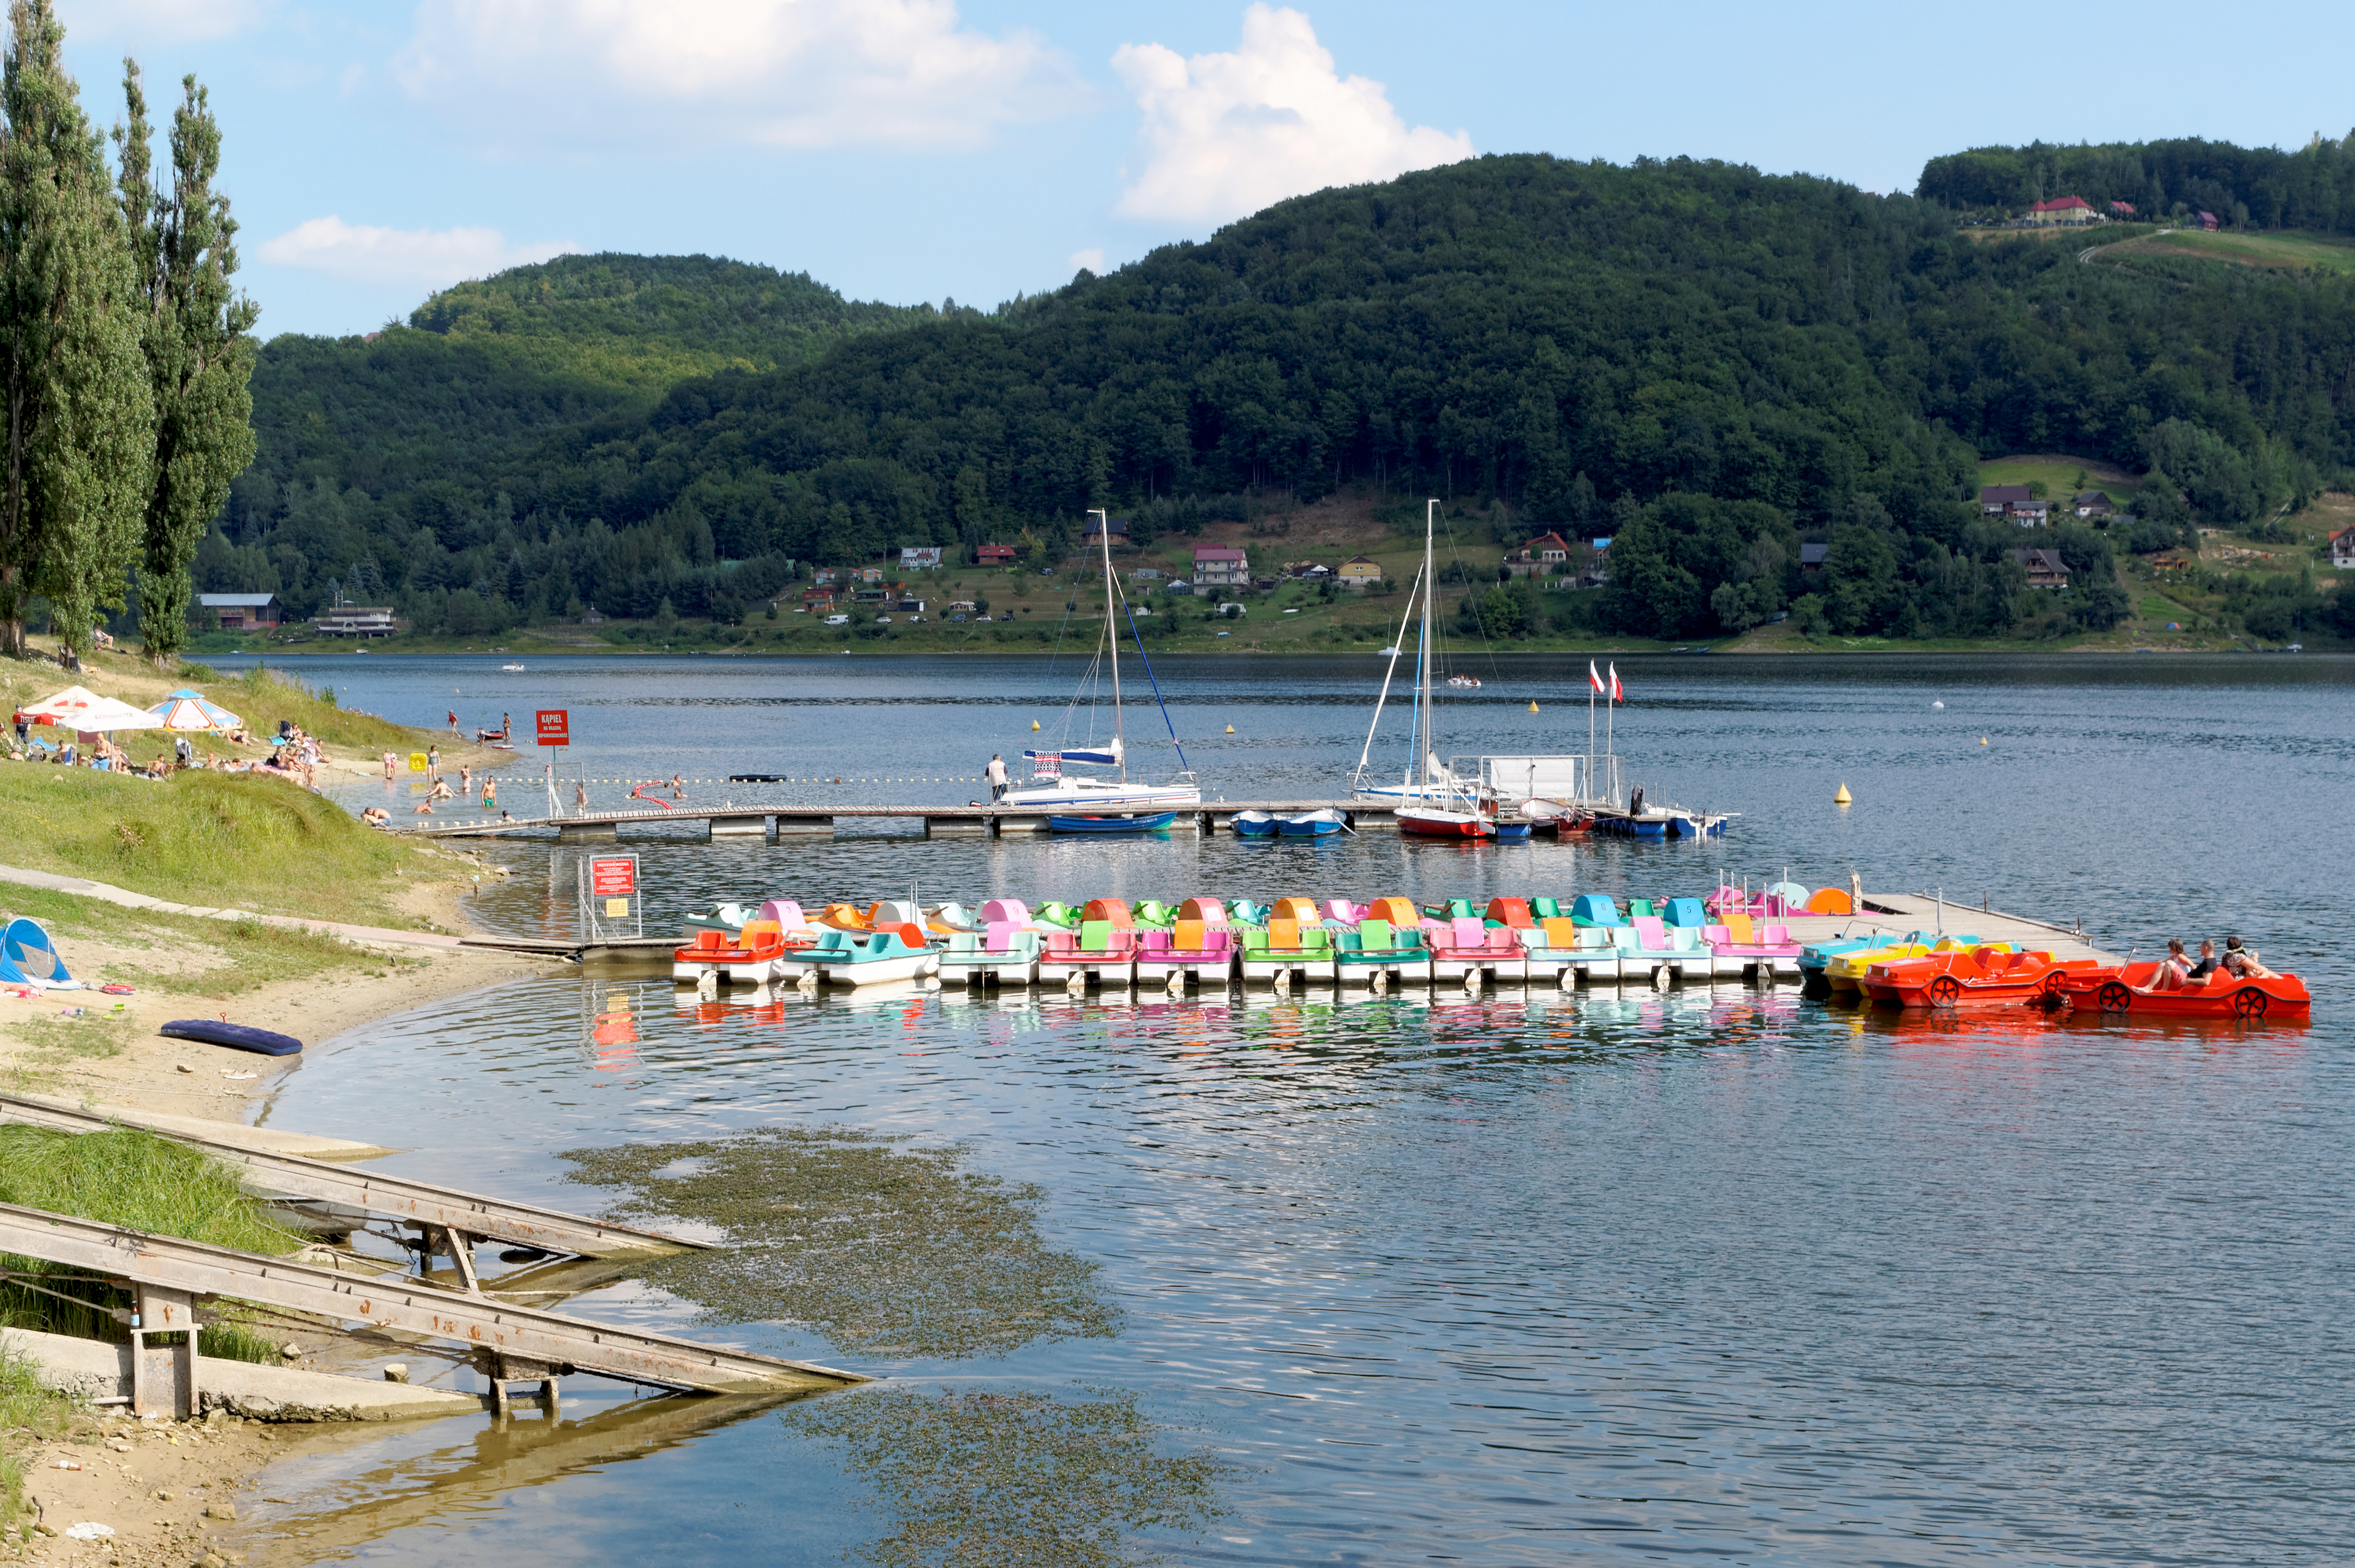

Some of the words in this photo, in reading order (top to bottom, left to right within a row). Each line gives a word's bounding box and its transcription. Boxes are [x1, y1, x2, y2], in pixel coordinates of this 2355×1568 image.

[20, 715, 36, 723] TYSKIE
[542, 714, 562, 725] KĄPIEL
[1013, 907, 1019, 915] 9
